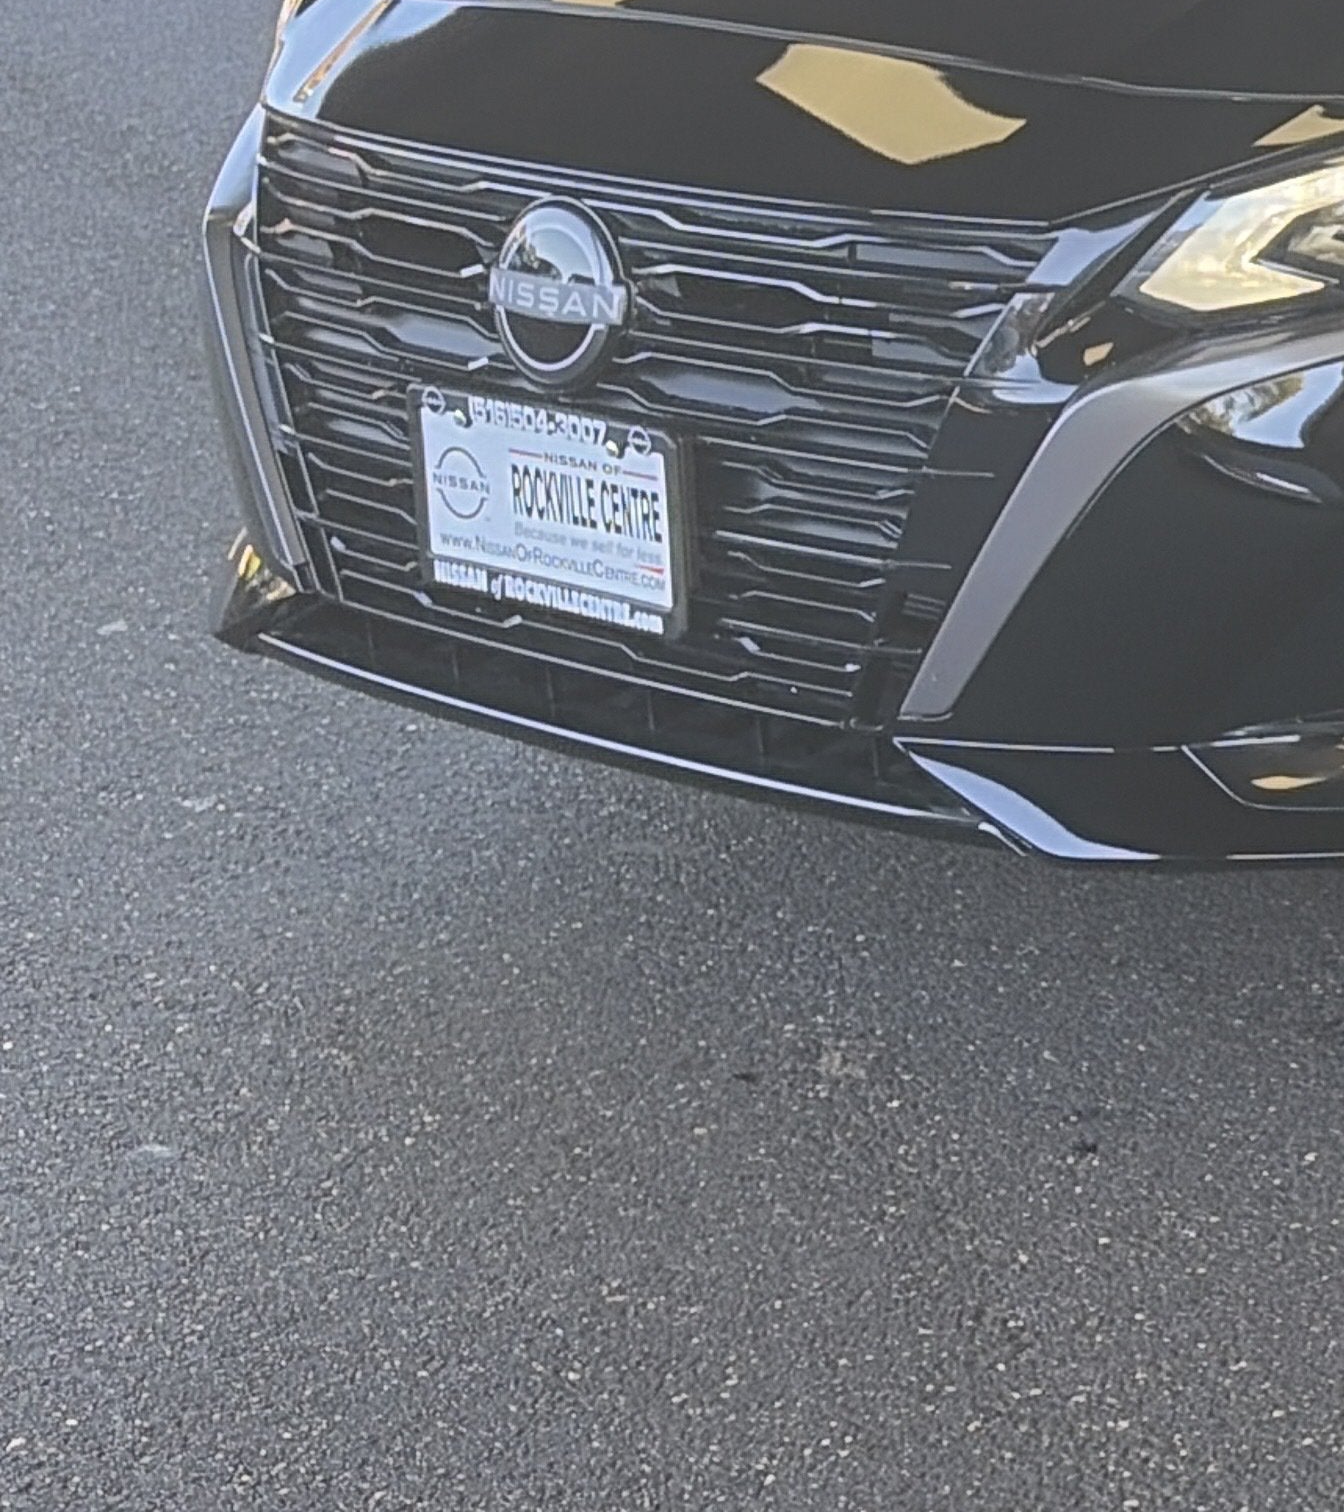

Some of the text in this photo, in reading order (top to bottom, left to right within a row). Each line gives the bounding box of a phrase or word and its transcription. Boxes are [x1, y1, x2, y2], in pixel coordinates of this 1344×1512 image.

[490, 272, 620, 320] NISSAN
[544, 452, 623, 476] NISSAN OF
[432, 472, 490, 494] NISSAN
[511, 464, 663, 543] ROCKVILLE CENTRE
